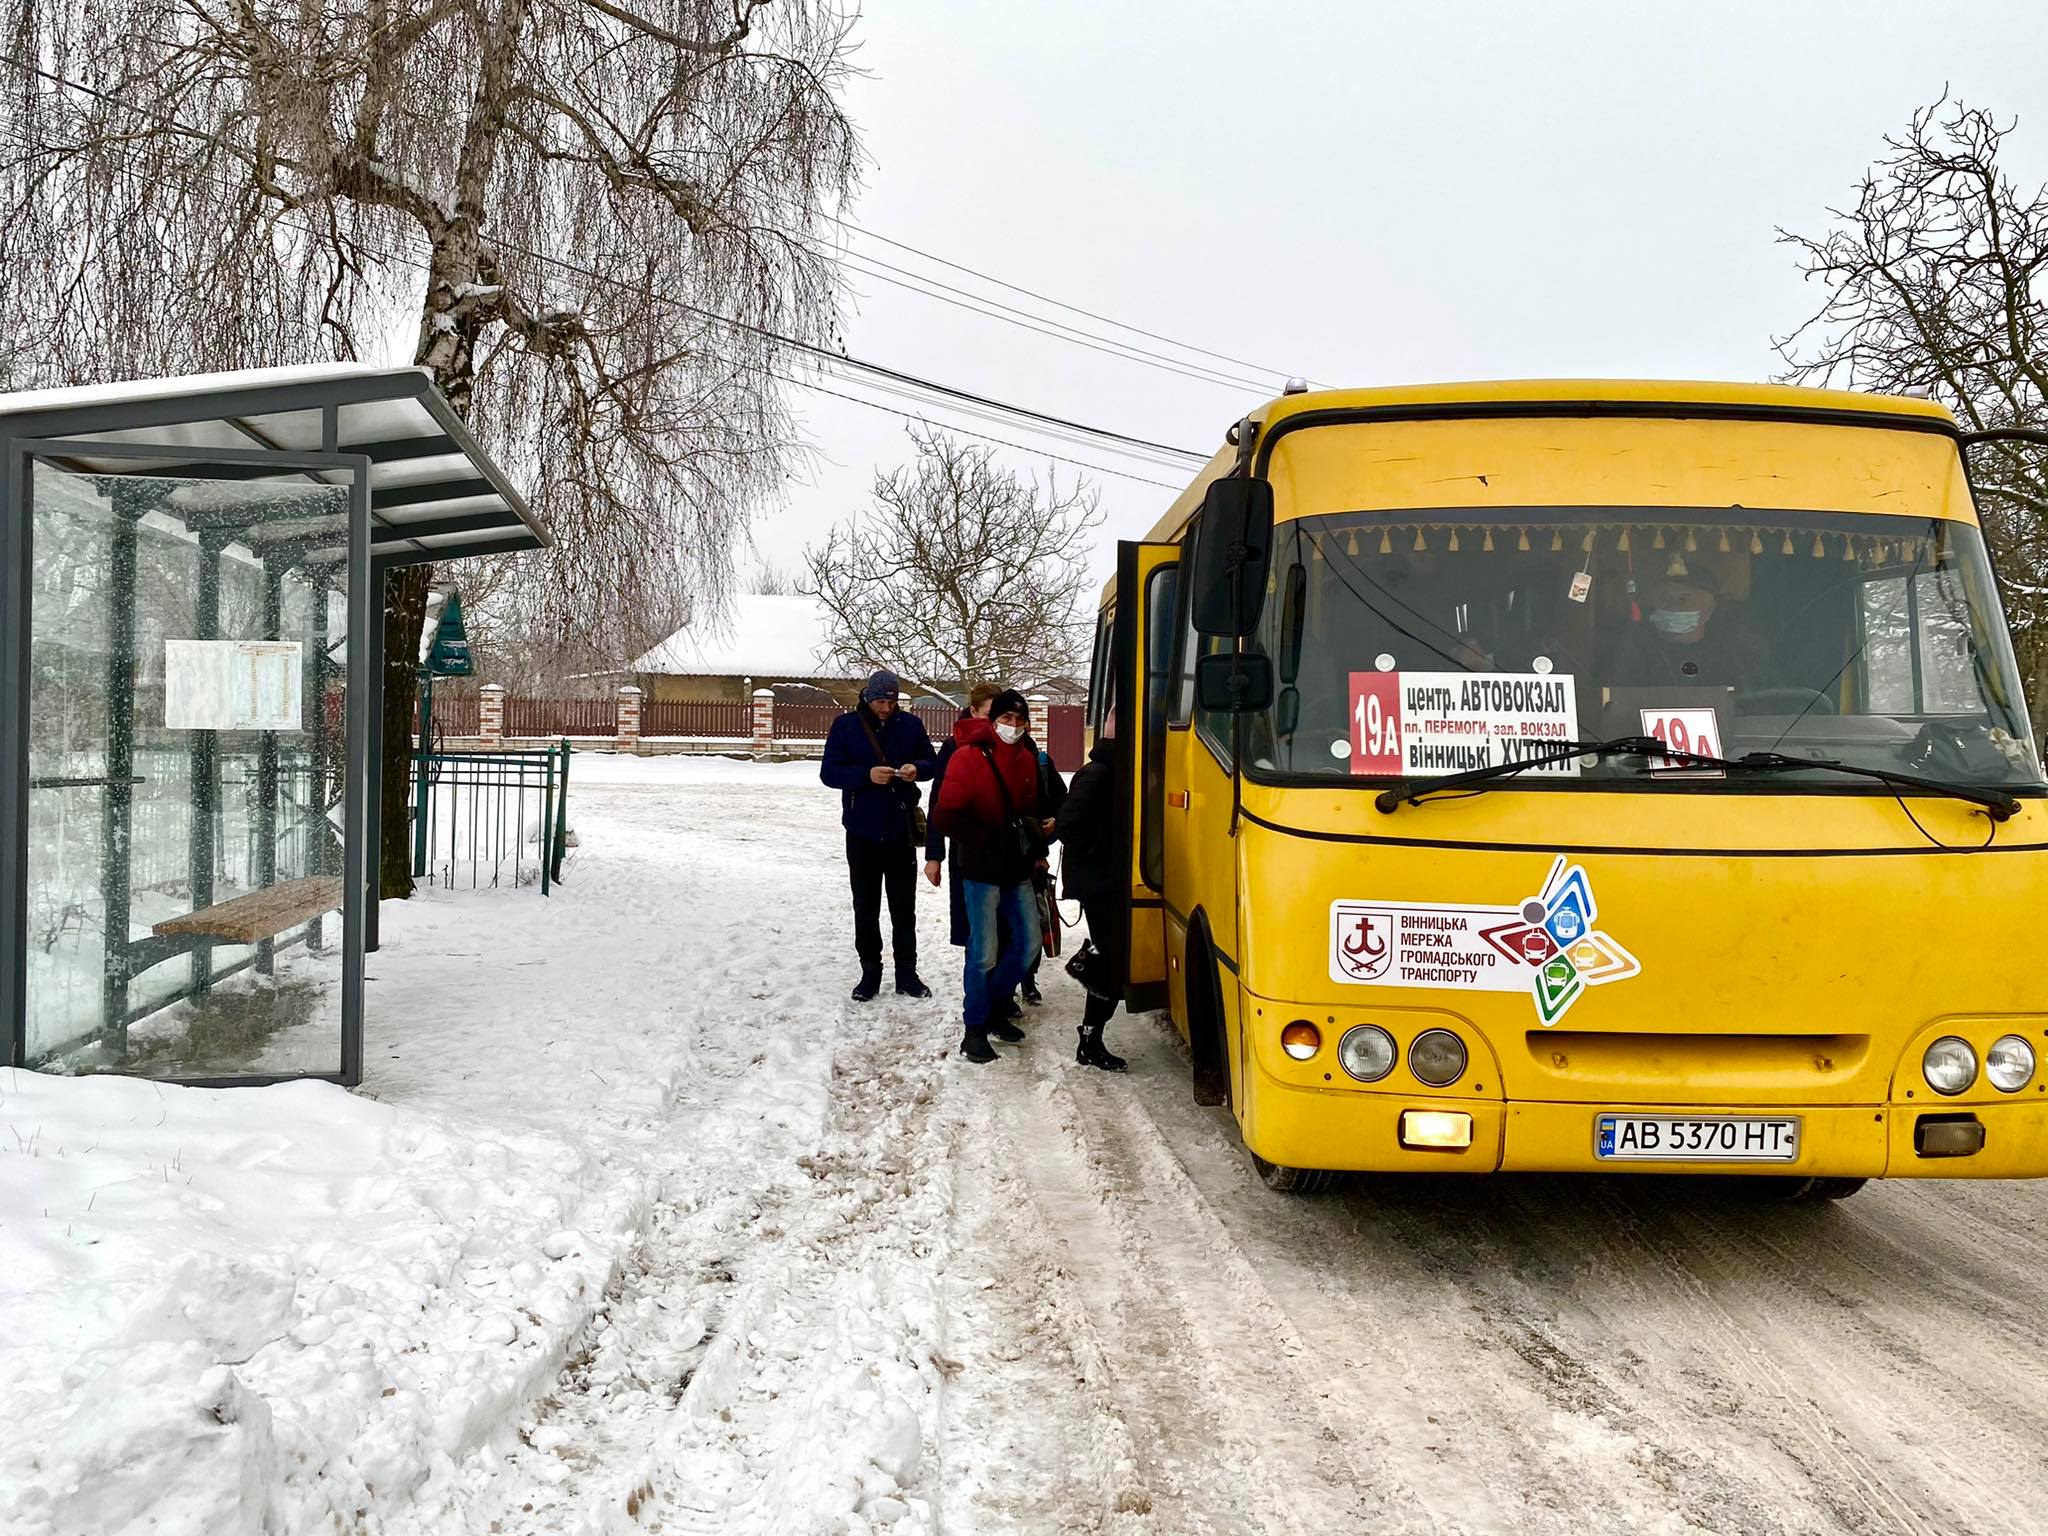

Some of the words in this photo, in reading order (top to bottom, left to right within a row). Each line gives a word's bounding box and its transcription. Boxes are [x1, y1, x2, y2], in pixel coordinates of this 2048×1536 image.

[1407, 687, 1456, 719] центр.
[1460, 680, 1566, 713] АВТОВОКЗАЛ
[1355, 694, 1400, 756] 19А
[1404, 723, 1421, 733] пл.
[1424, 720, 1491, 737] ПЕРЕМОГИ,
[1493, 724, 1517, 736] зал.
[1520, 722, 1567, 737] ВОКЗАЛ
[1652, 718, 1717, 768] 19А
[1409, 736, 1491, 773] вінницькі
[1401, 915, 1468, 932] ВІННИЦЬКА
[1400, 933, 1453, 947] МЕРЕЖА
[1400, 950, 1496, 967] ГРОМАДСЬКОГО
[1400, 967, 1478, 983] ТРАНСПОРТУ
[1619, 1121, 1661, 1149] AB
[1669, 1122, 1737, 1150] 5370
[1745, 1123, 1787, 1150] HT
[1600, 1140, 1614, 1150] UA
